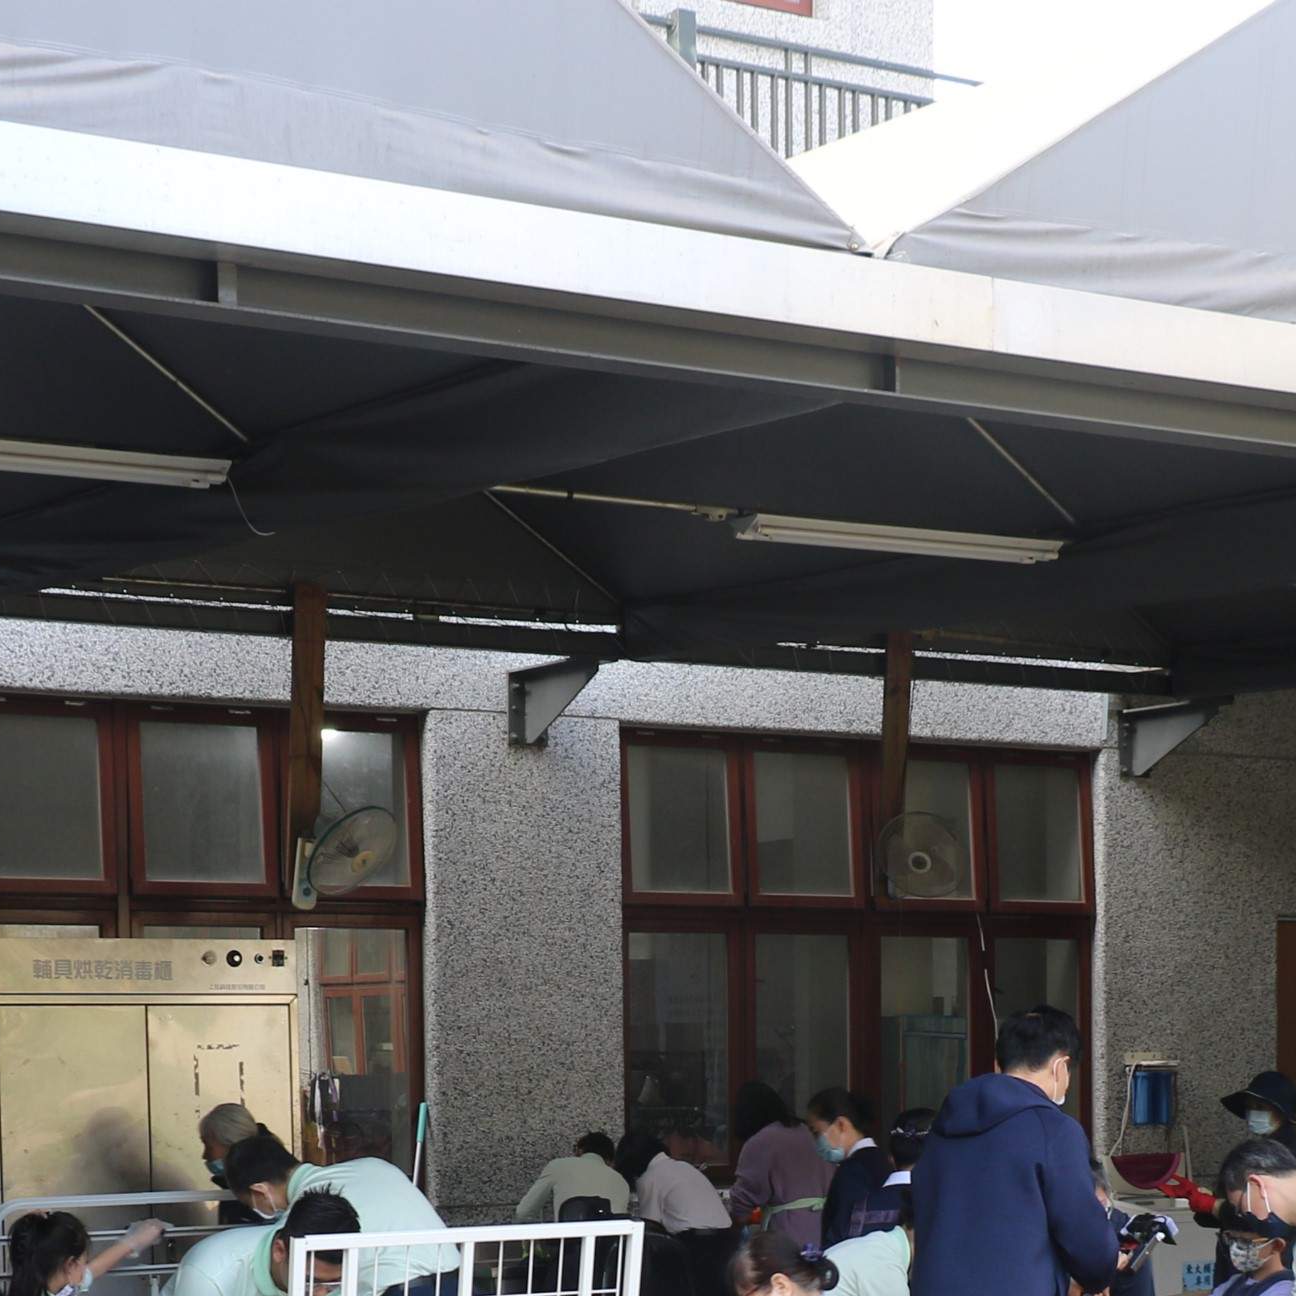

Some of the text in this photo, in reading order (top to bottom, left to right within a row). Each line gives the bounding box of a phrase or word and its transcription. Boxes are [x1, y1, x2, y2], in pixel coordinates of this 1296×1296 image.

[33, 959, 173, 981] 輔具烘乾消毒櫃
